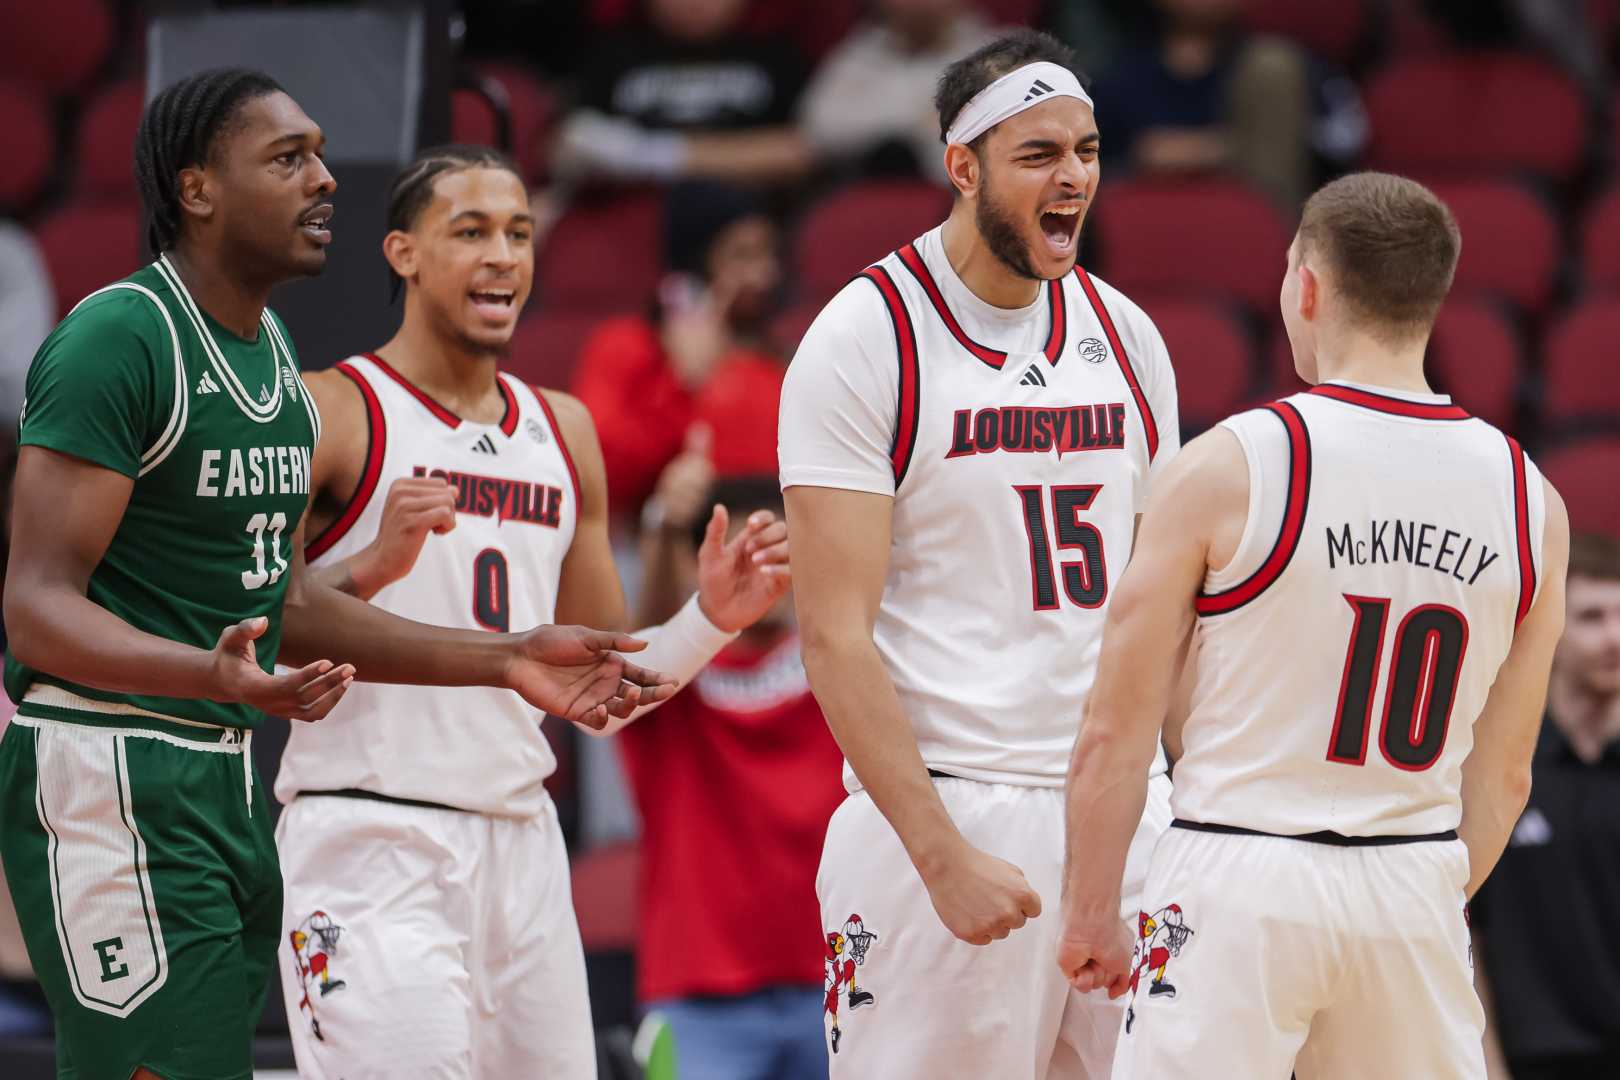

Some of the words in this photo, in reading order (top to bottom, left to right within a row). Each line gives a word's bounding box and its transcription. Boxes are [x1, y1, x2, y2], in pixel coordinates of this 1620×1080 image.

[944, 403, 1125, 461] LOUISVILLE
[196, 447, 311, 496] EASTERN
[413, 466, 562, 529] UISVILLE
[241, 512, 288, 590] 33
[1011, 484, 1108, 611] 15
[1326, 520, 1499, 585] McKNEELY
[472, 547, 511, 633] 0
[1326, 593, 1469, 772] 10
[93, 936, 129, 983] E
